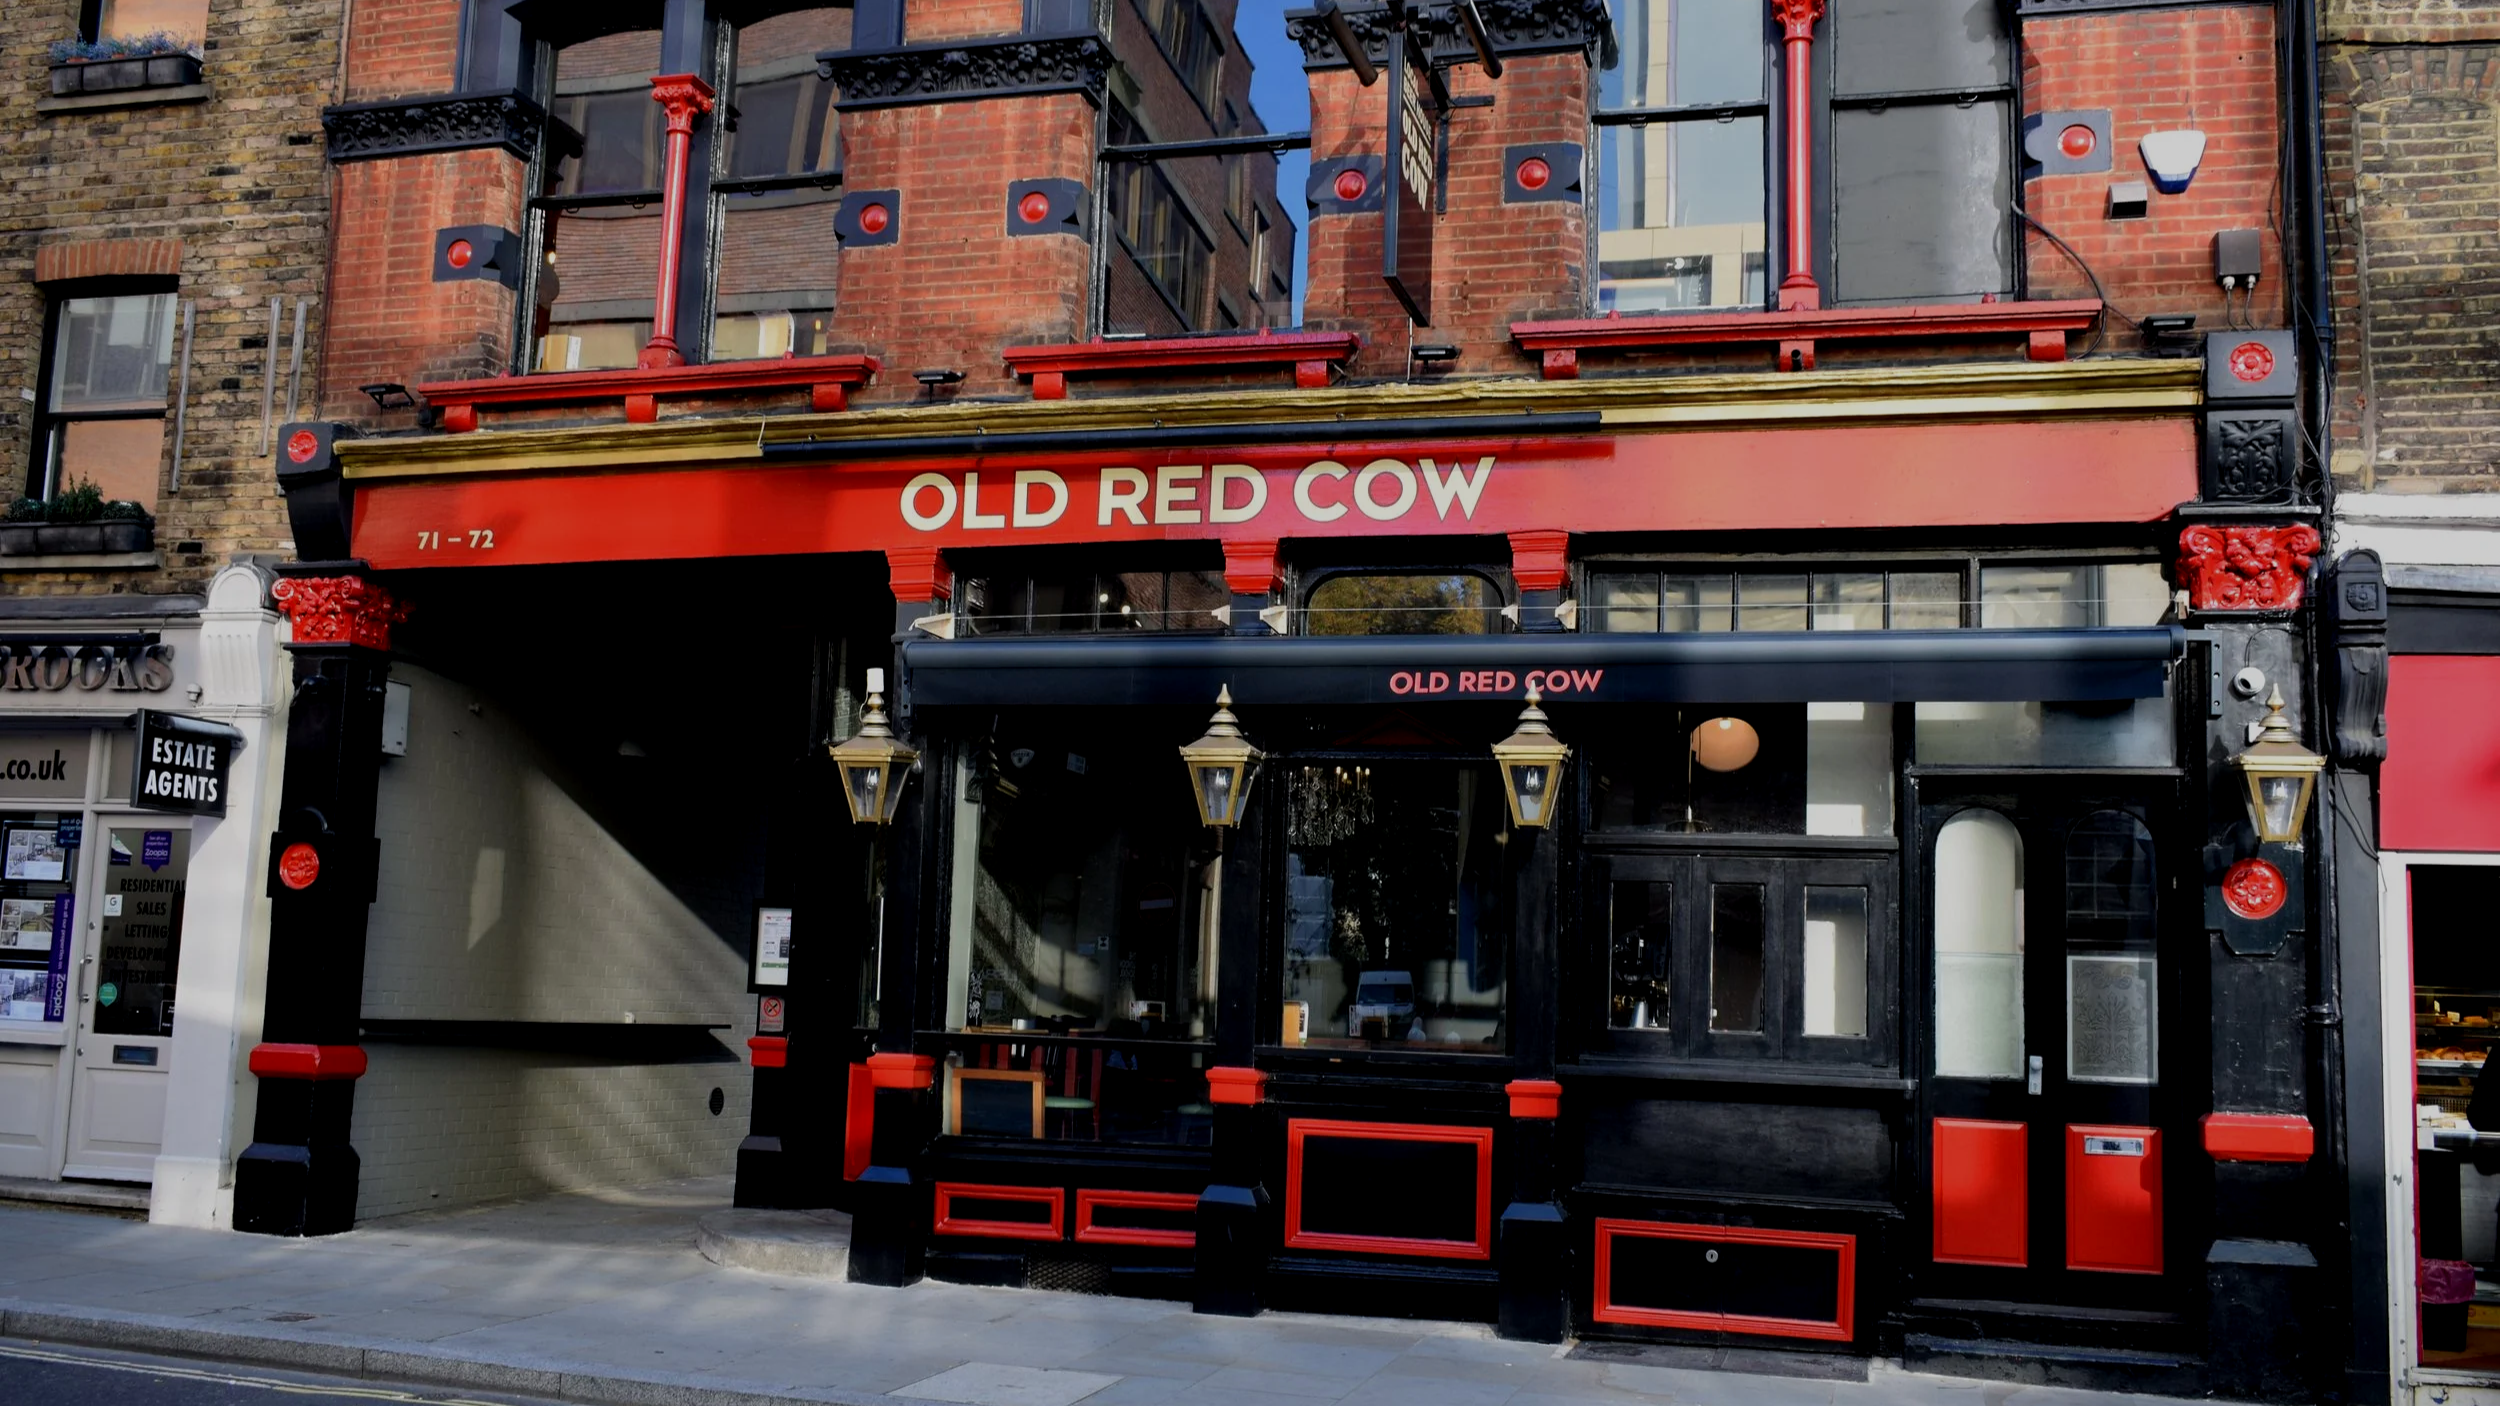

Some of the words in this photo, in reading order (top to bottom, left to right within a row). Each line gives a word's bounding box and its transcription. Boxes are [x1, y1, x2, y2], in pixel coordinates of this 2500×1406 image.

[1403, 55, 1419, 98] LOCAL
[1403, 74, 1417, 112] BEER
[1402, 109, 1418, 152] OLD
[1418, 137, 1433, 180] RED
[1401, 142, 1428, 212] COW
[900, 472, 1069, 532] OLD
[1097, 463, 1268, 526] RED
[1293, 456, 1497, 523] COW
[417, 531, 439, 550] 71
[468, 529, 494, 549] 72
[0, 645, 175, 692] ROOKS
[1389, 671, 1450, 695] OLD
[1459, 670, 1516, 692] RED
[1524, 669, 1604, 693] COW
[152, 737, 216, 771] ESTATE
[144, 769, 218, 803] AGENTS
[145, 848, 168, 857] Zoopla
[120, 878, 186, 894] RESIDENTIAL
[136, 901, 167, 917] SALES
[124, 923, 170, 939] LETTING
[53, 973, 66, 1017] Zoopla
